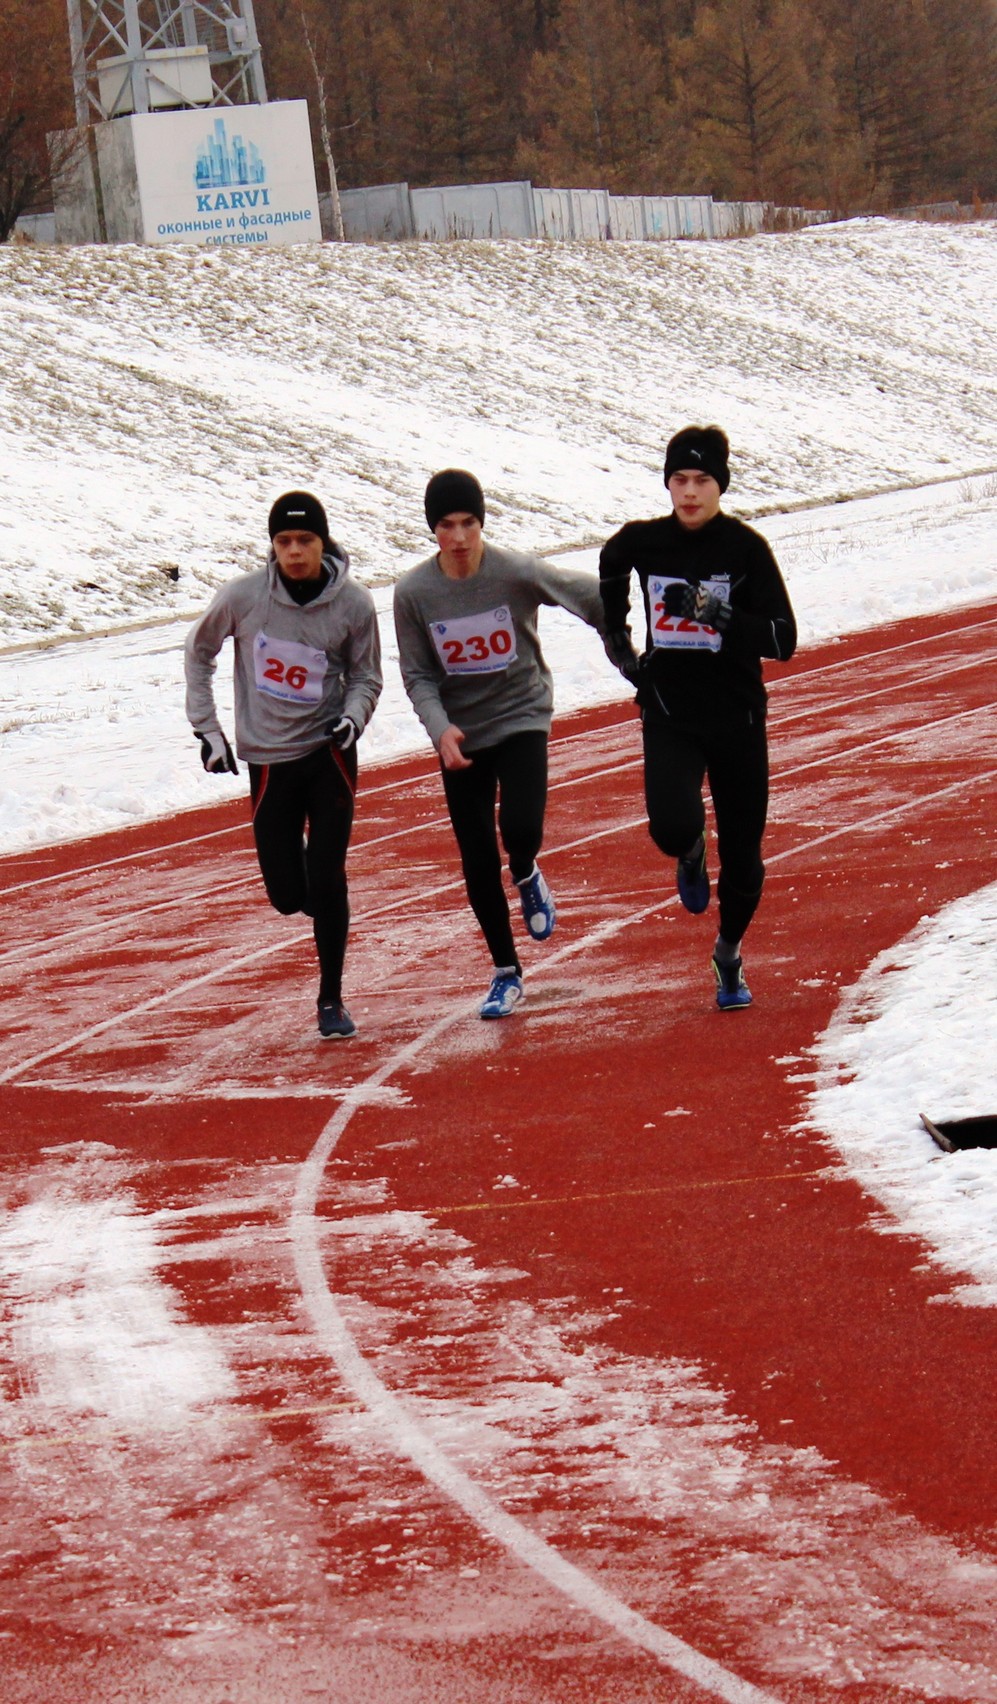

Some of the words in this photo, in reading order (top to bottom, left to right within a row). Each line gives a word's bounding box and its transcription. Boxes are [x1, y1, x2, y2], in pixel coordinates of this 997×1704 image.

[196, 189, 270, 212] KARVI
[157, 219, 222, 235] оконные
[226, 217, 235, 228] и
[238, 209, 312, 230] фасадные
[206, 231, 268, 245] системы
[442, 629, 512, 664] 230
[263, 657, 309, 690] 26
